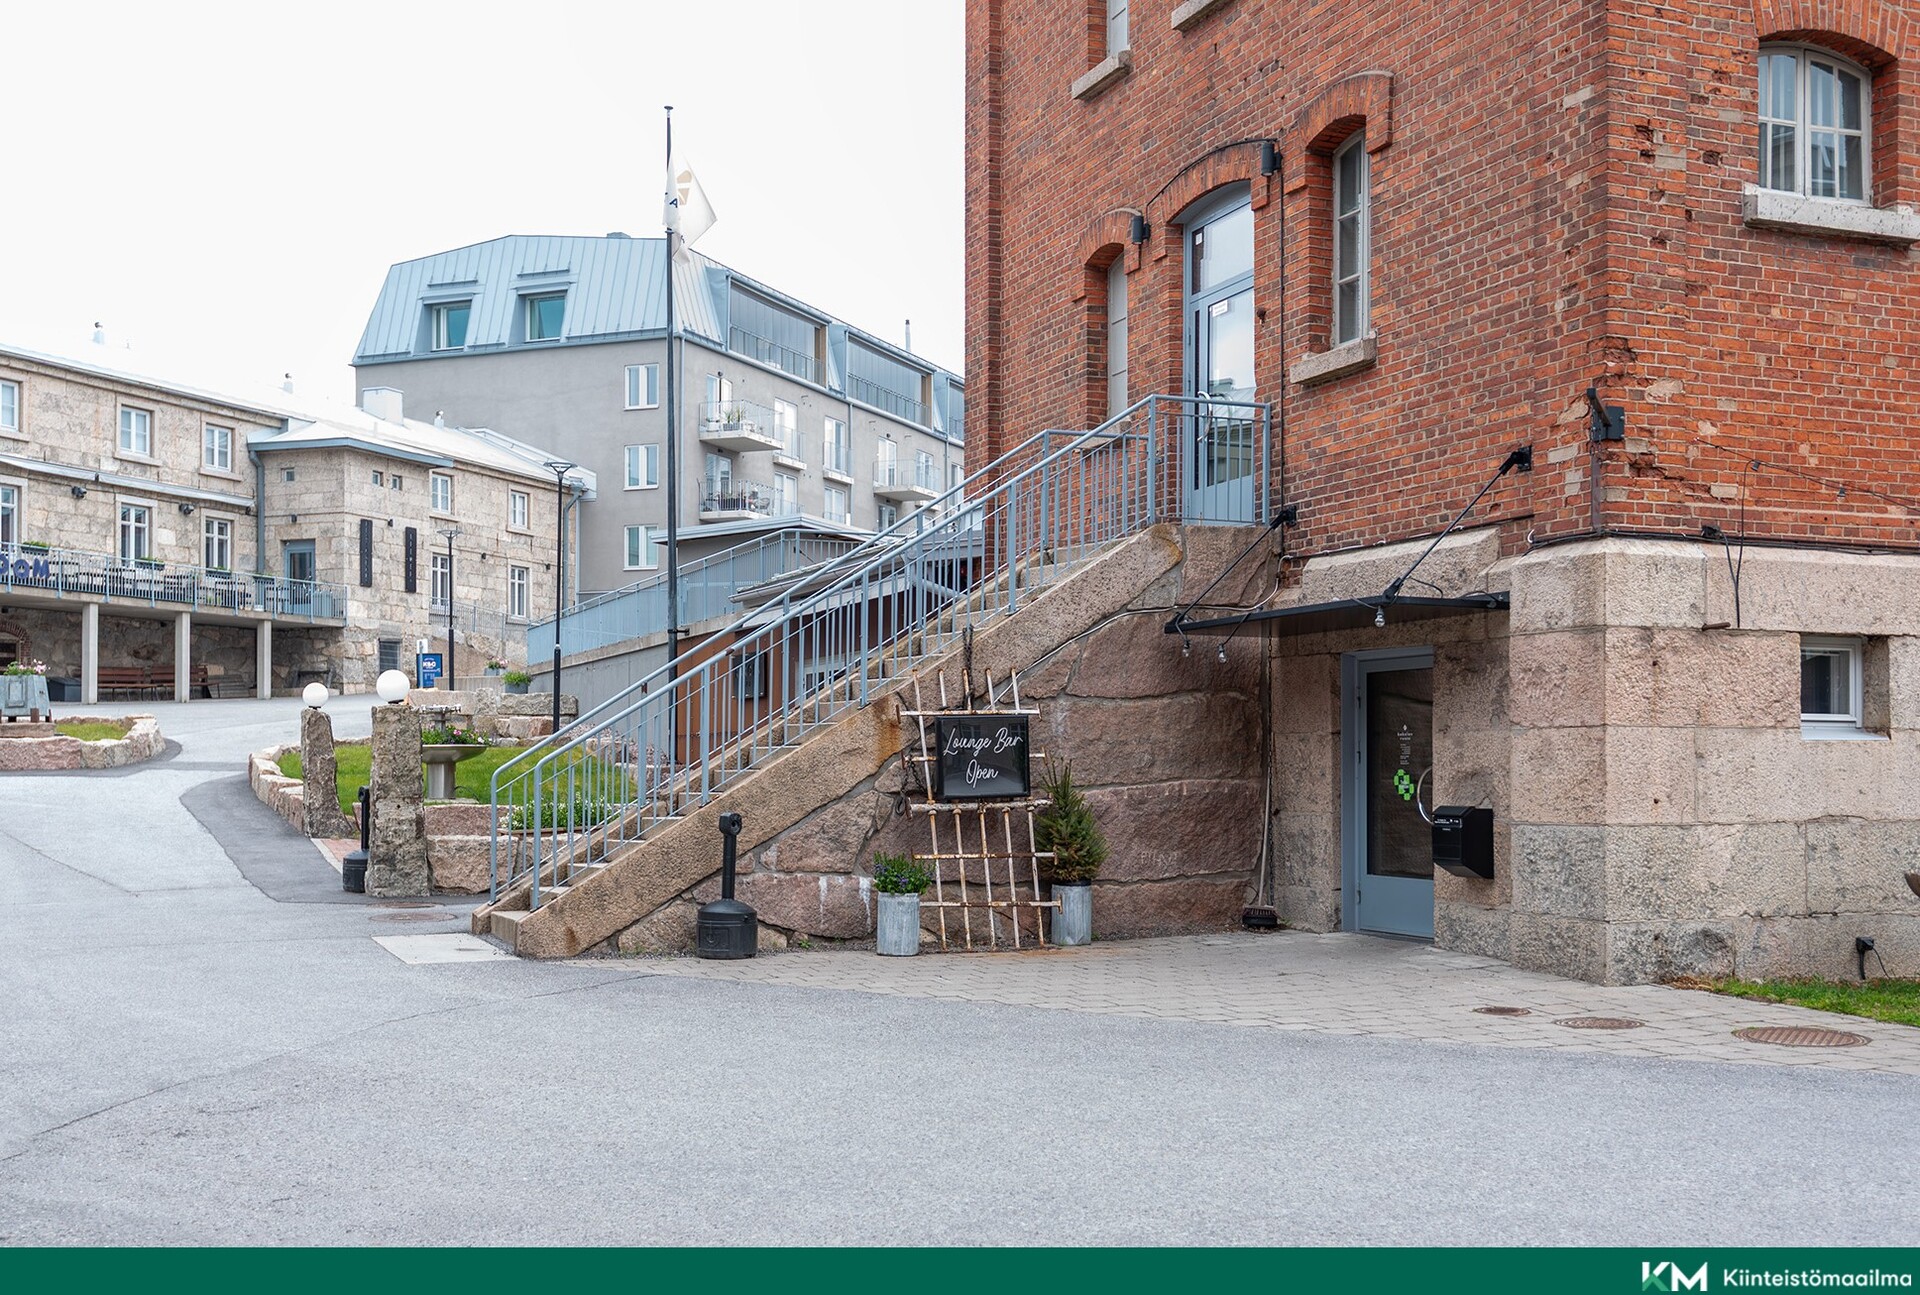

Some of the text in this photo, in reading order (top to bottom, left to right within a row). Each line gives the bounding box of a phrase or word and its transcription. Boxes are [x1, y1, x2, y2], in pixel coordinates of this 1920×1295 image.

[943, 727, 1024, 757] Lounge Bar
[966, 759, 999, 788] Open
